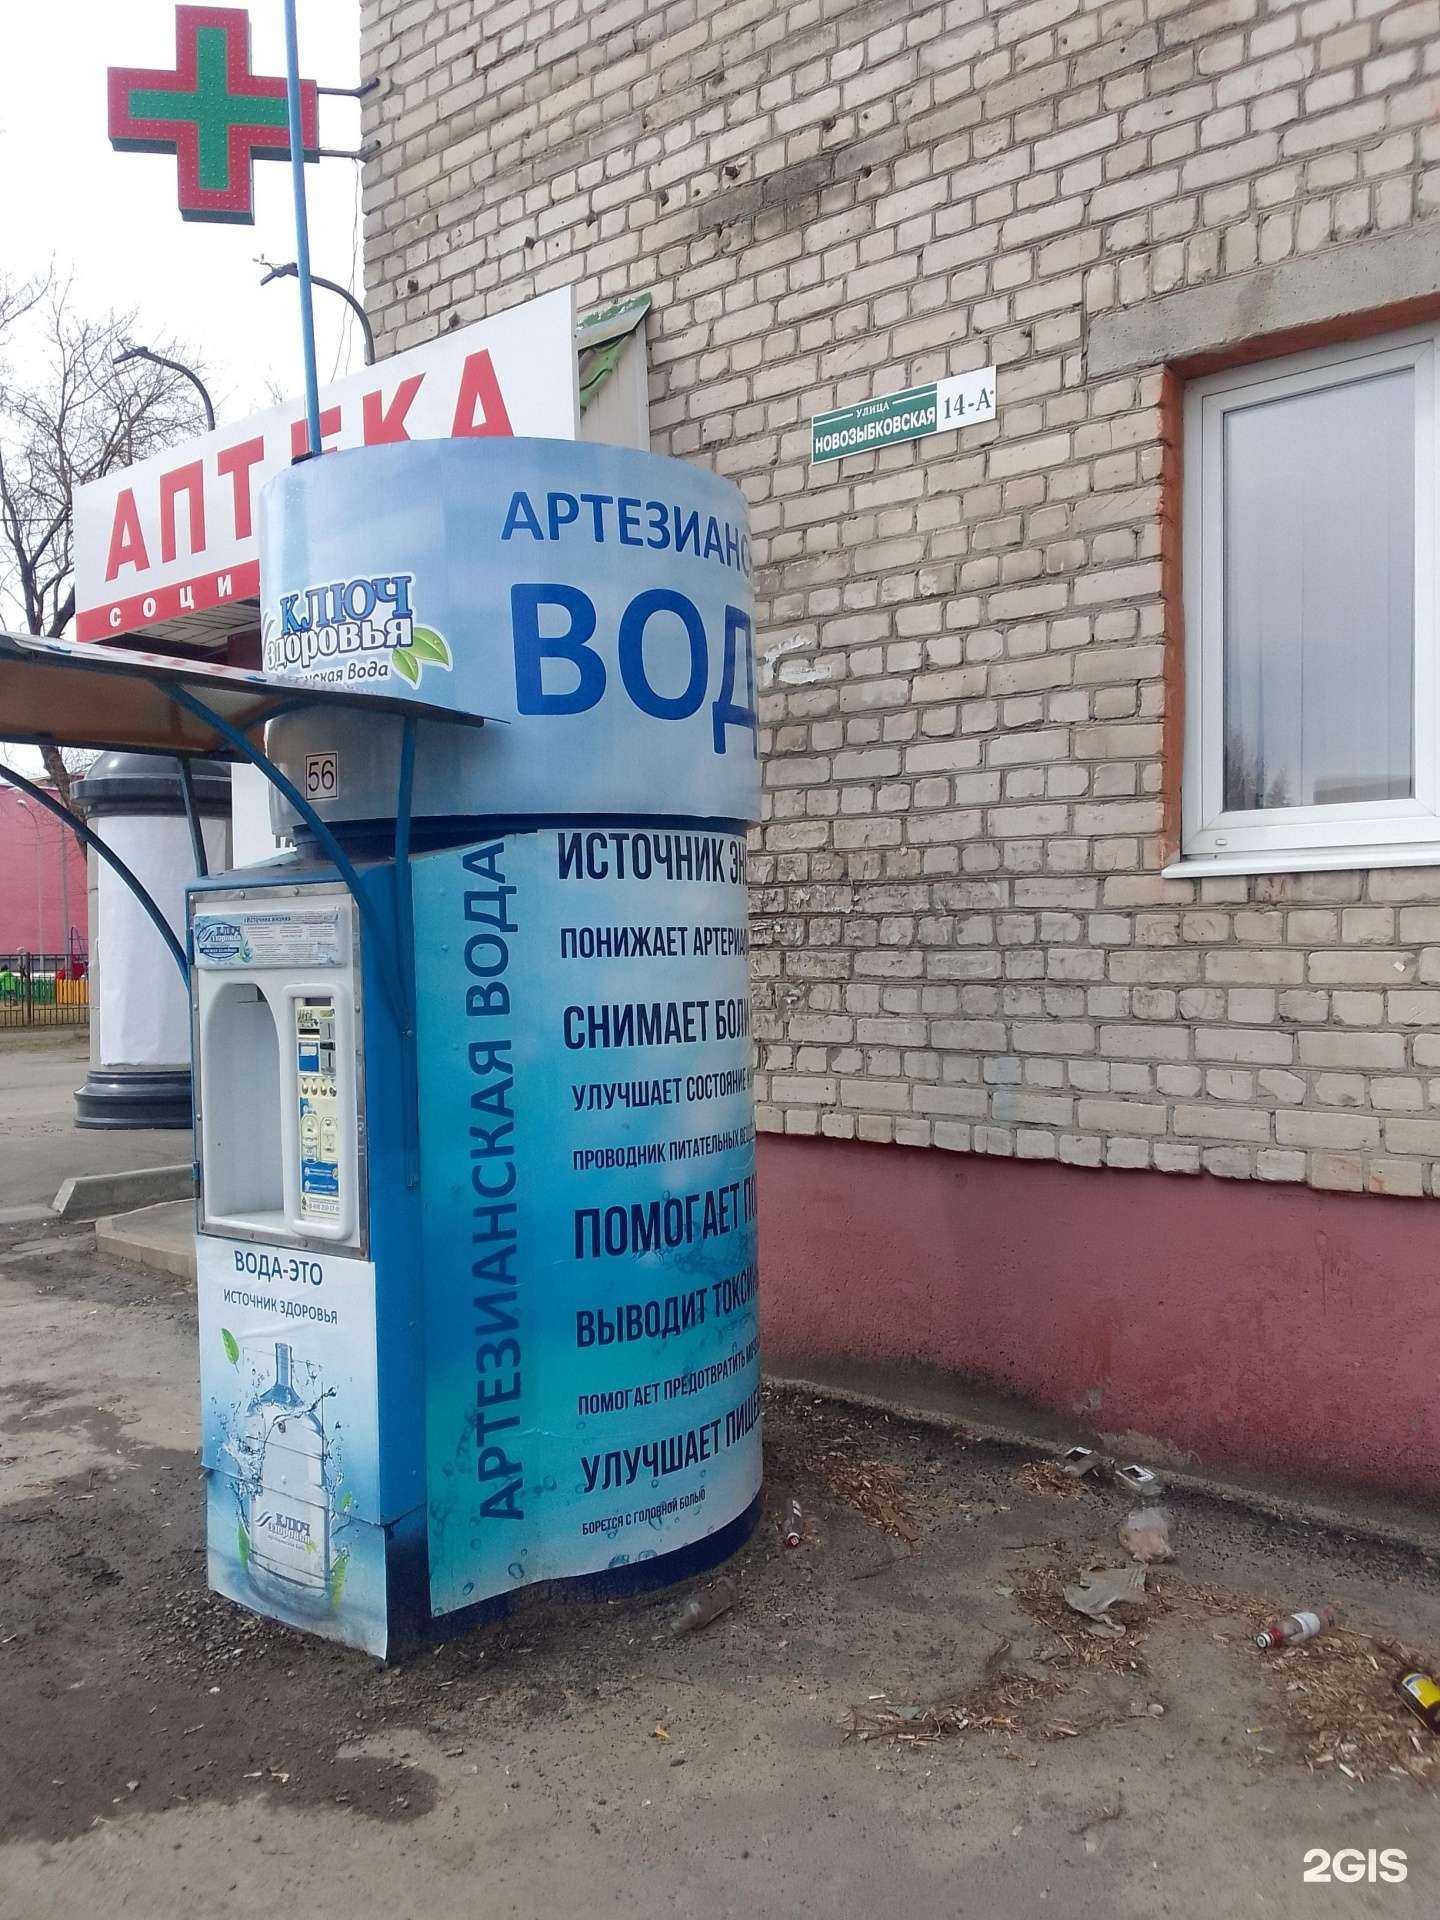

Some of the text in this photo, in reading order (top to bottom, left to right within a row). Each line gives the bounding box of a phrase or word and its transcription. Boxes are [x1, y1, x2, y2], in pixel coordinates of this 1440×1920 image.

[815, 406, 936, 454] НОВОЗЫБКОВСКАЯ
[855, 401, 890, 419] УЛИЦА
[109, 574, 232, 627] СОЦИ
[280, 576, 413, 635] КЛЮЧ
[510, 583, 757, 760] ВОД
[308, 760, 335, 792] 56
[557, 832, 747, 885] ИСТОЧНИК ЭН
[560, 926, 748, 959] ПОНИЖАЕТ АРТЕРИА
[563, 1001, 709, 1050] СНИМАЕТ
[572, 1077, 682, 1112] УЛУЧШАЕТ
[686, 1067, 746, 1102] СОСТОЯНИЕ
[573, 1142, 665, 1171] ПРОВОДНИК
[669, 1128, 738, 1161] ПИТАТЕЛЬНЫХ
[462, 841, 523, 1520] АРТЕЗИАНСКАЯ ВОДА
[574, 1182, 740, 1259] ПОМОГАЕТ
[234, 1250, 323, 1286] ВОДА-ЭТО
[223, 1288, 338, 1325] ИСТОЧНИК ЗДОРОВЬЯ
[576, 1287, 707, 1348] ВЫВОДИТ
[578, 1353, 746, 1416] ПОМОГАЕТ ПРЕДОТВРАТИТЬ
[580, 1418, 721, 1494] УЛУЧШАЕТ
[582, 1488, 706, 1536] БОРЕТСЯ С ГОЛОВНОЙ БОЛЬЮ
